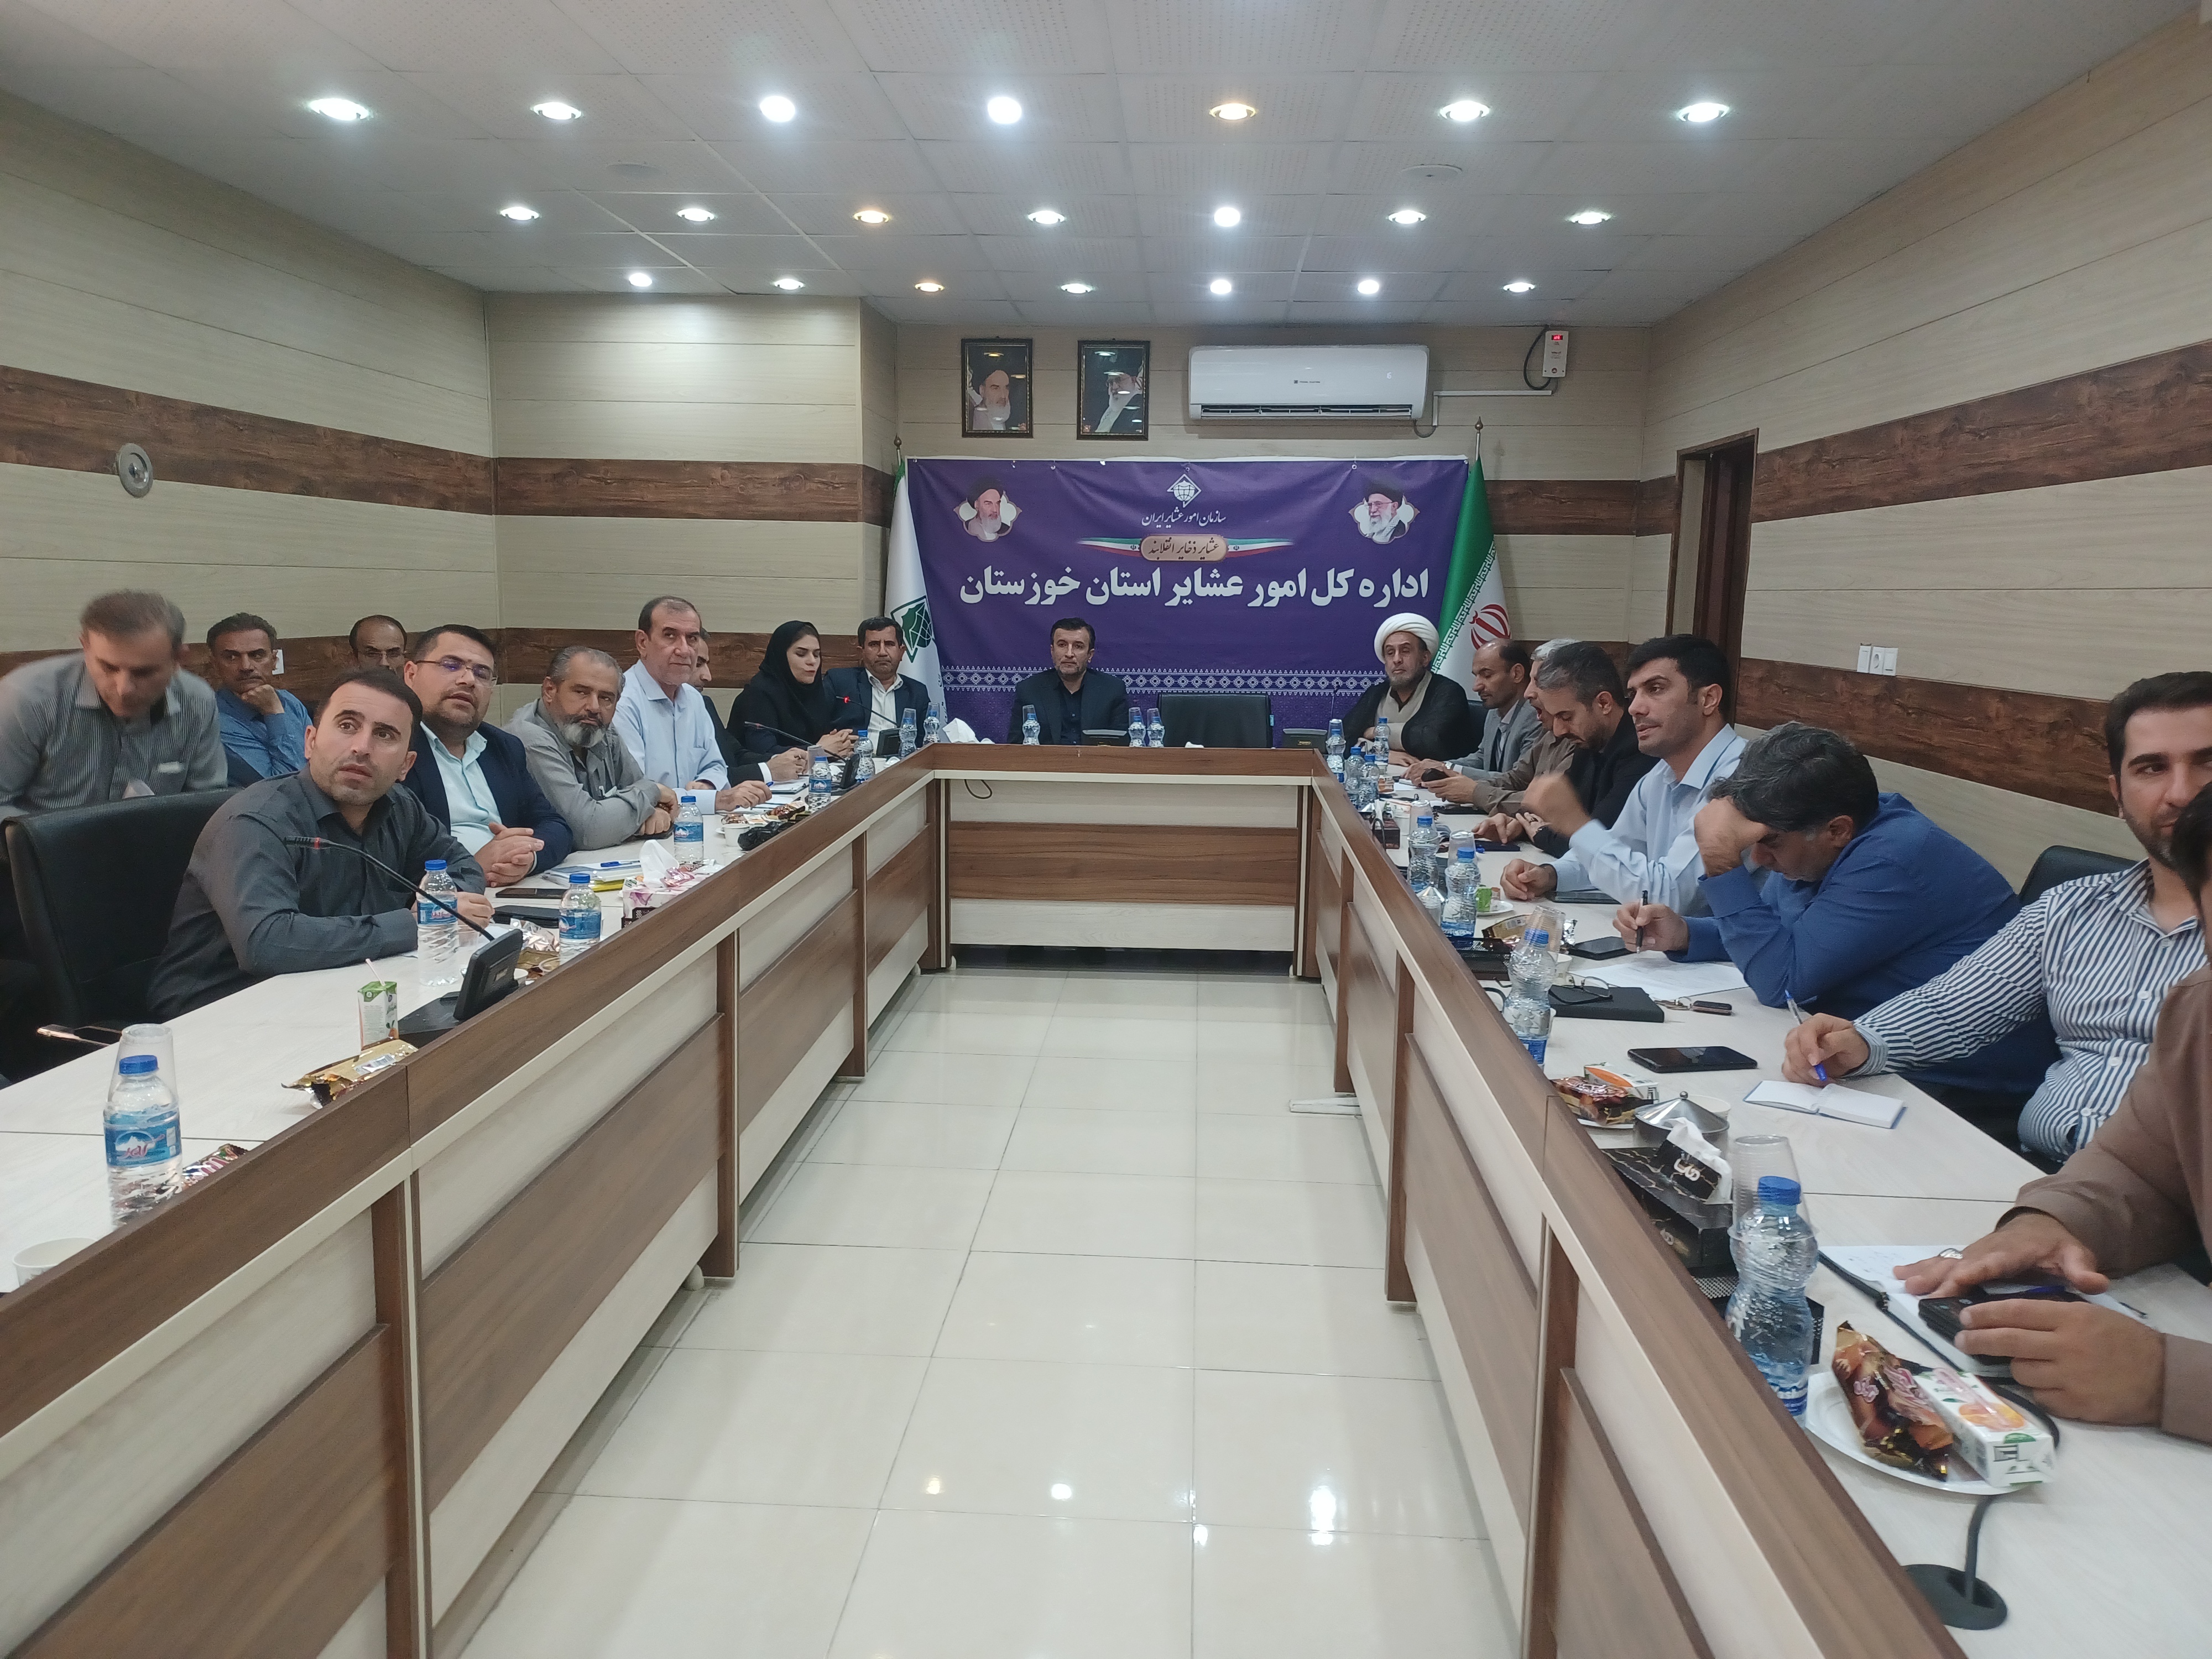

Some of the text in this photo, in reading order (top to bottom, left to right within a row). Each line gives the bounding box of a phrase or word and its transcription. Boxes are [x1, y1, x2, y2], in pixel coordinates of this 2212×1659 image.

[1141, 506, 1226, 529] سازمان امور عشایر ایران
[1176, 540, 1197, 560] ذخایر
[1198, 537, 1219, 560] عشایر
[960, 565, 1428, 607] اداره کل امور عشایر استان خوزستان
